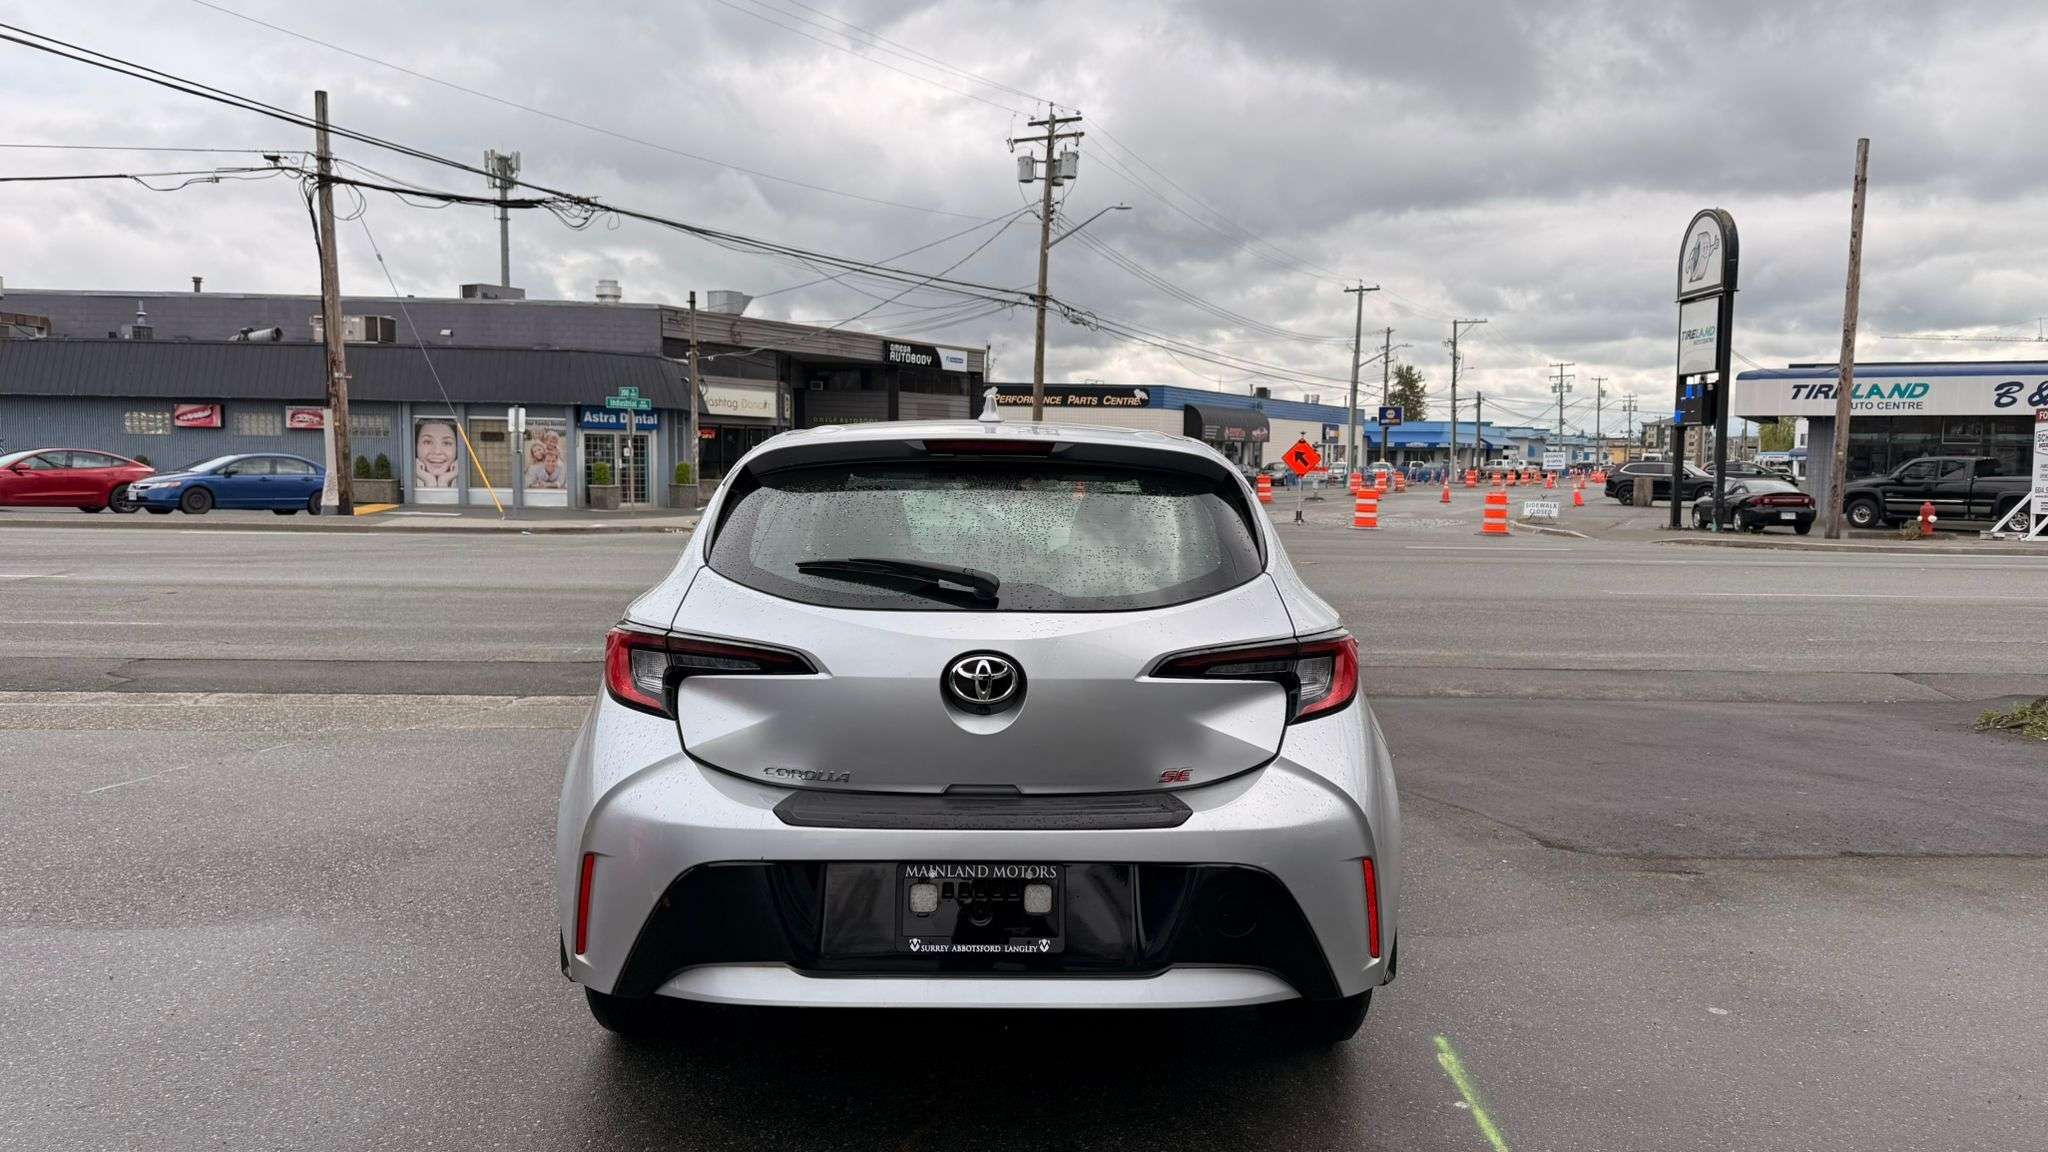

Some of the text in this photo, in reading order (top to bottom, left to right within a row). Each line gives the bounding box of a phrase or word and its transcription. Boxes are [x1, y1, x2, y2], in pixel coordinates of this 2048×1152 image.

[890, 352, 932, 365] AUTOBODY
[1067, 395, 1098, 406] PARTS
[1994, 381, 2024, 408] B
[1877, 401, 1923, 410] CENTRE
[584, 411, 658, 425] Astra Dntal
[763, 767, 851, 783] COROLLA
[1159, 768, 1194, 783] SE
[905, 865, 1057, 878] MAINLAND MOTORS
[921, 944, 1037, 953] SURREY ABBOTSFORD LANGLEY
